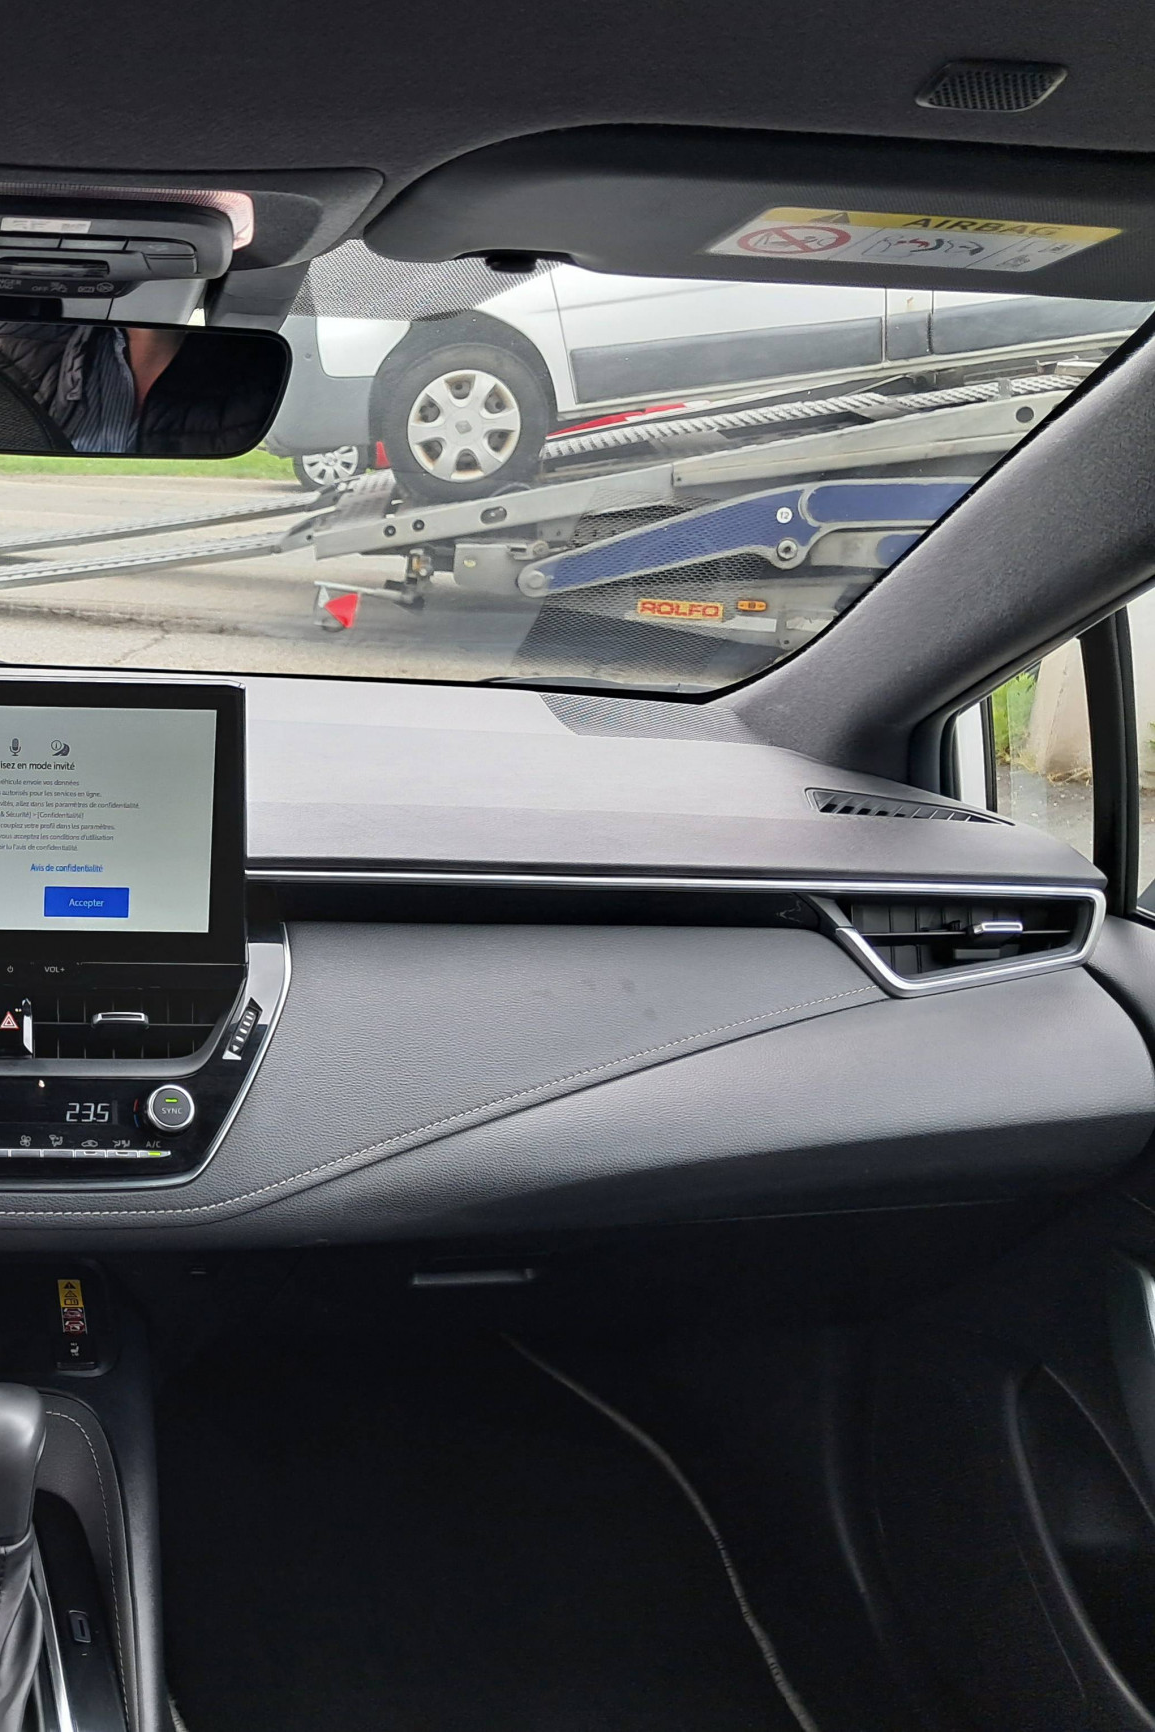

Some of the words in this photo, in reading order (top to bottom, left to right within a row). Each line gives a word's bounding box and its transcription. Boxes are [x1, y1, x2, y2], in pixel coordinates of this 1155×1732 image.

[902, 217, 1062, 236] AIRBAG
[780, 511, 790, 520] 12
[640, 601, 720, 617] ROLFO
[29, 761, 52, 770] mode
[53, 761, 76, 771] invité
[30, 863, 44, 872] Avis
[45, 864, 54, 872] de
[55, 864, 104, 873] confidentialité
[68, 898, 105, 909] Accepter
[161, 1107, 182, 1115] SYNC
[146, 1140, 162, 1148] A/C
